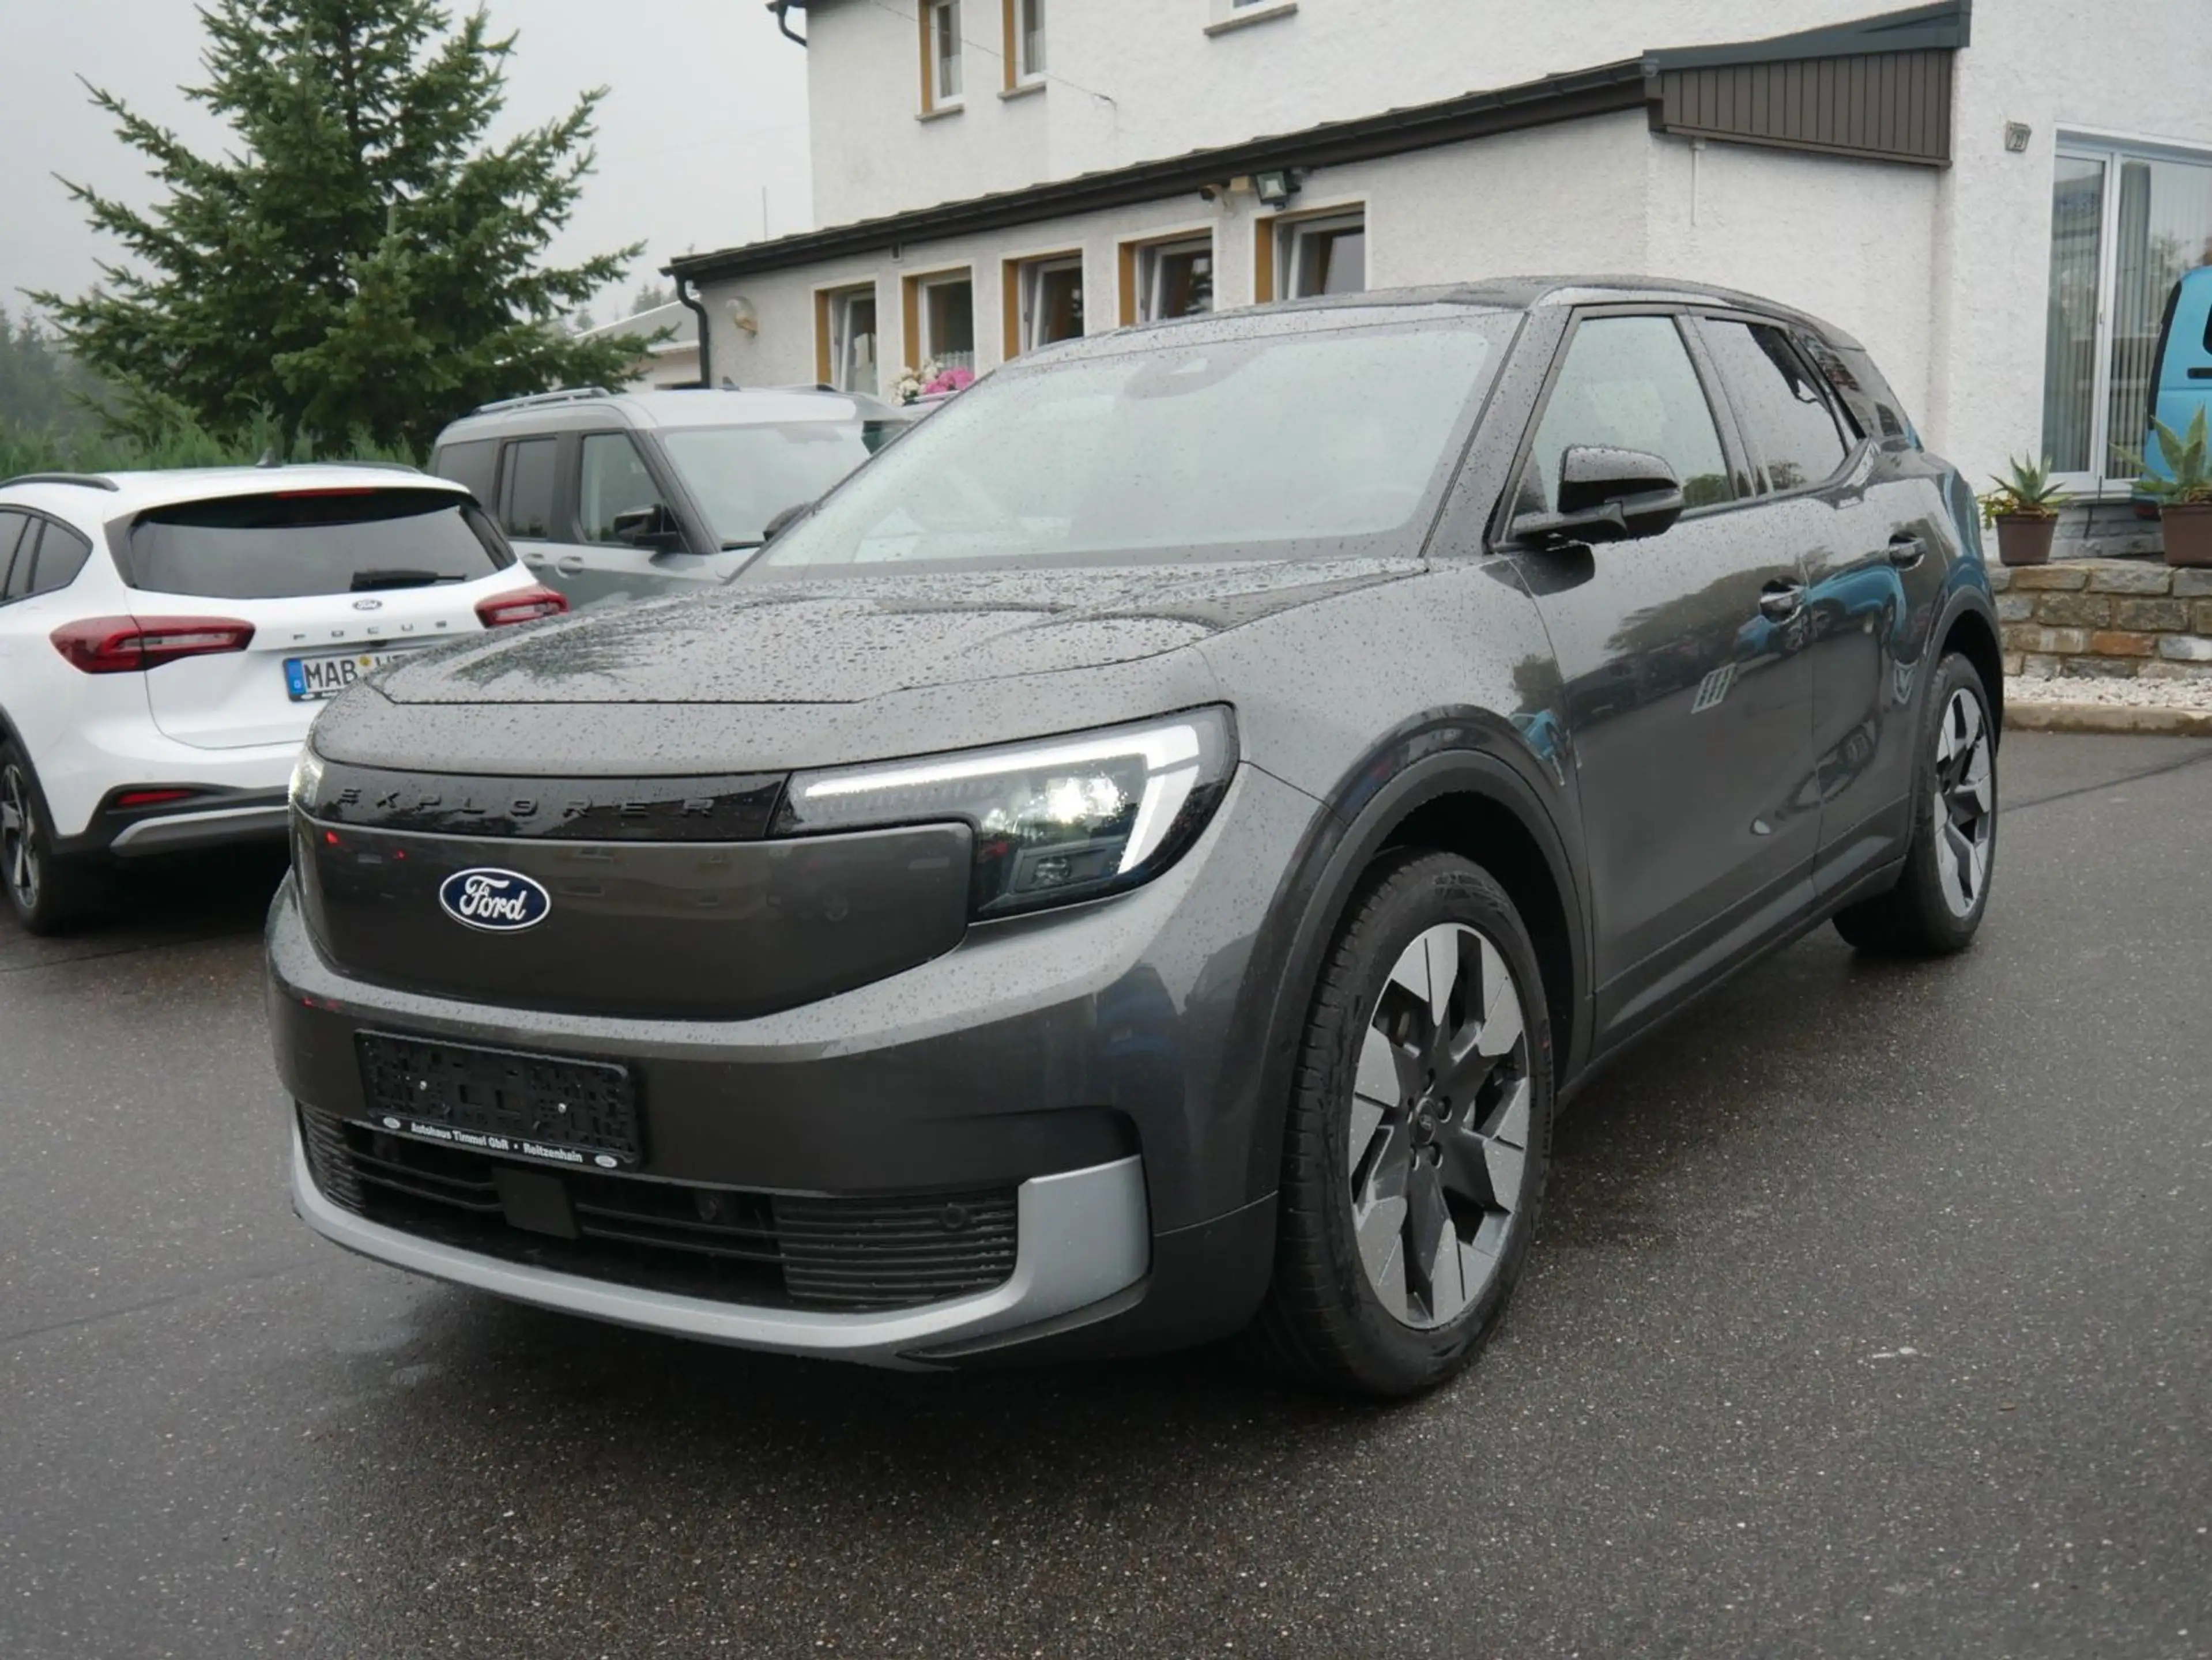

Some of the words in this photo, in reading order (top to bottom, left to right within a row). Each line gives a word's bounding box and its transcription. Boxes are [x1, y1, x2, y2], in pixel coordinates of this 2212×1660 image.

[293, 620, 447, 640] FOCUS
[303, 659, 358, 689] MAB
[336, 787, 715, 817] EXPLORER
[459, 874, 527, 920] Ford
[410, 1122, 452, 1140] Autohaus
